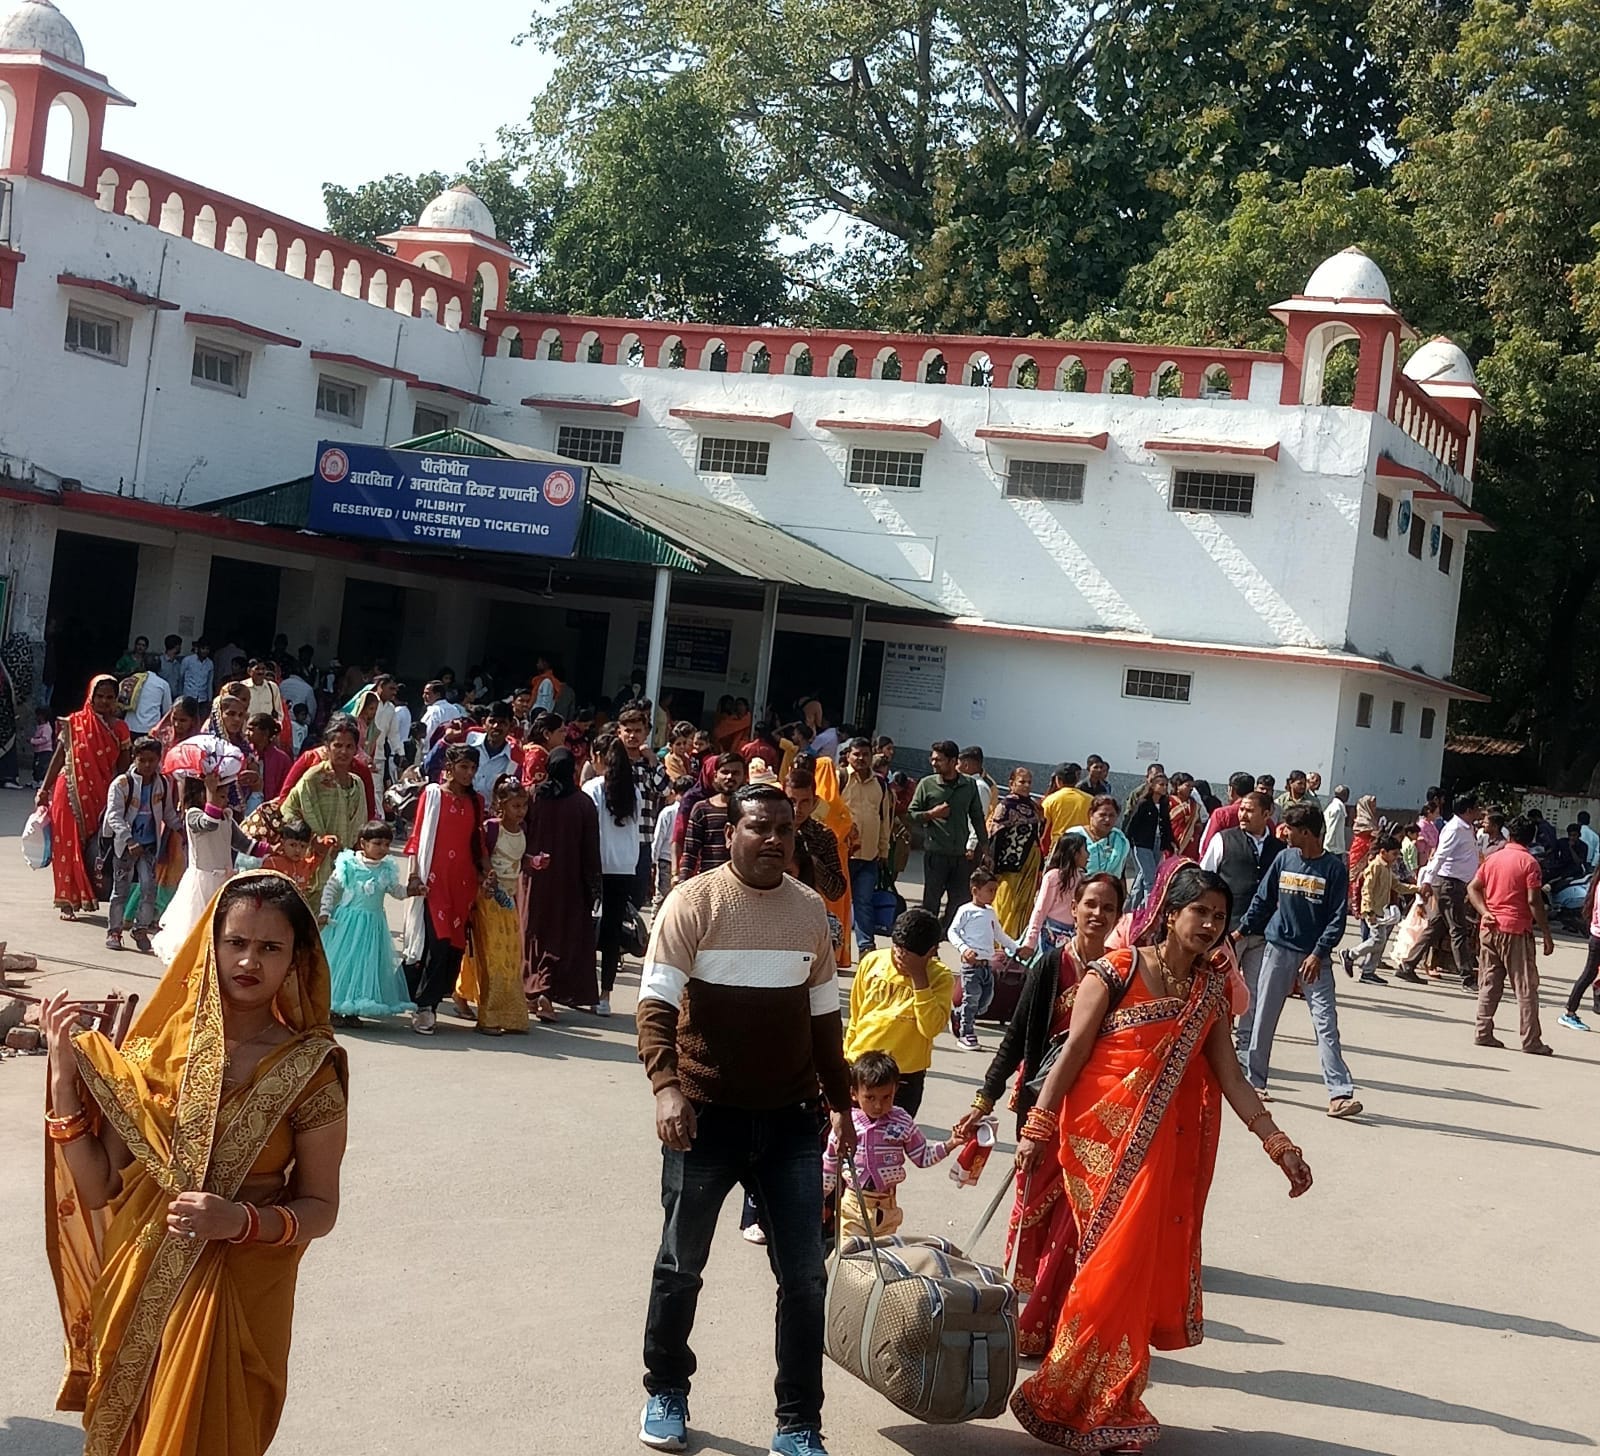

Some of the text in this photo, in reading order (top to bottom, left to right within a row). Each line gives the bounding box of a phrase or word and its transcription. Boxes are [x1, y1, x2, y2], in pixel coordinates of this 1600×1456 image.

[421, 457, 469, 477] पीलीभीत
[350, 470, 394, 488] आरक्षित
[397, 474, 405, 490] /
[410, 477, 463, 495] अनारक्षित
[466, 480, 497, 498] टिकट
[499, 486, 540, 503] प्रणाली
[416, 498, 466, 513] PILIBHIT
[332, 502, 393, 518] RESERVED
[402, 510, 481, 528] UNRESERVED
[484, 518, 550, 536] TICKETING
[414, 525, 461, 540] SYSTEM
